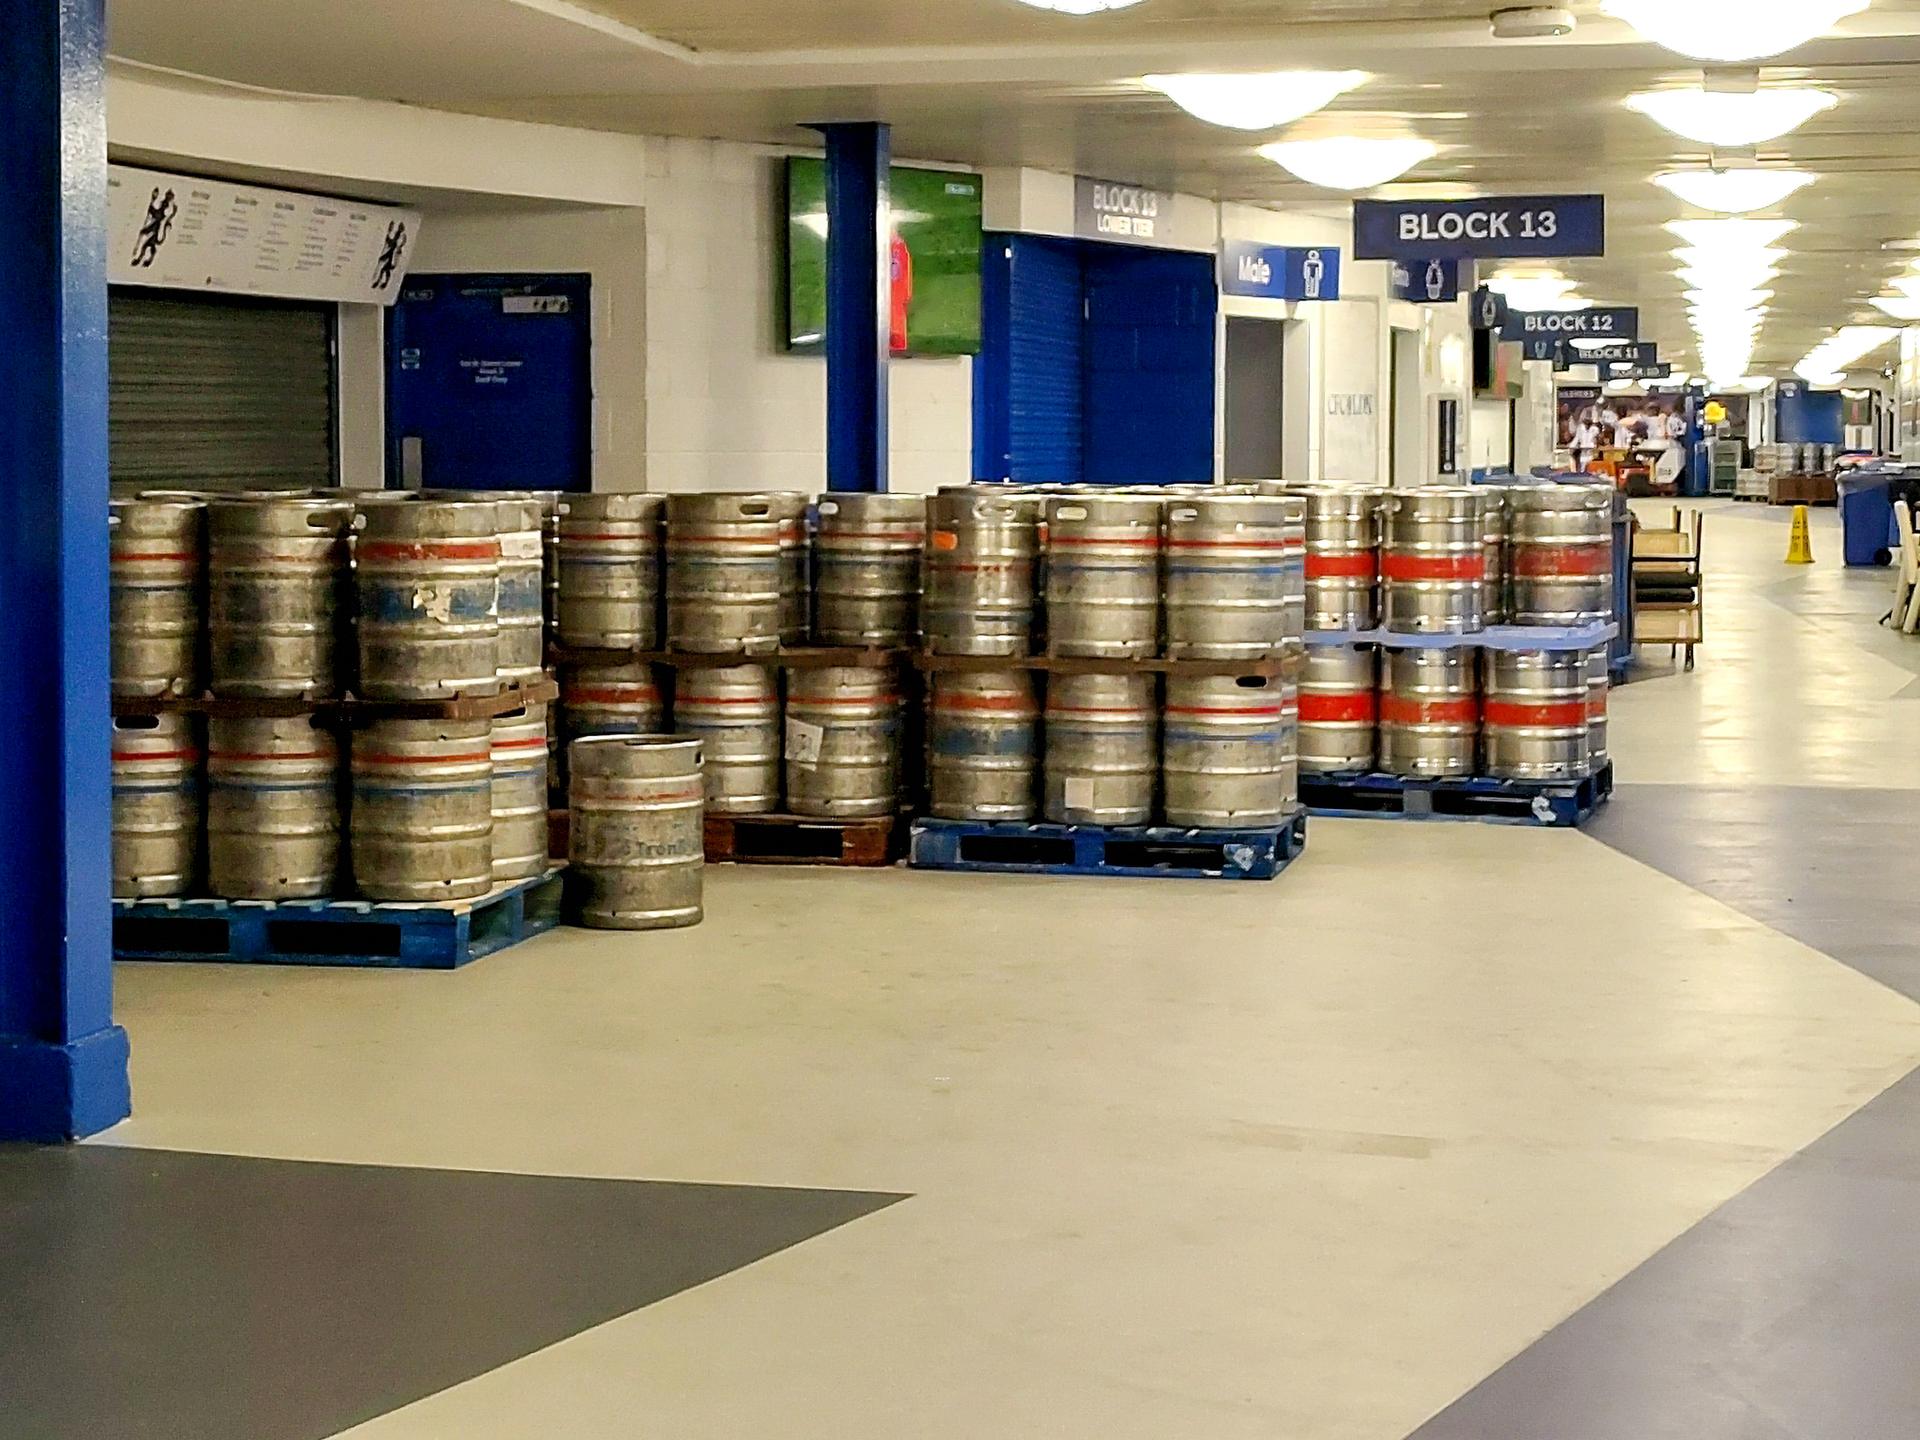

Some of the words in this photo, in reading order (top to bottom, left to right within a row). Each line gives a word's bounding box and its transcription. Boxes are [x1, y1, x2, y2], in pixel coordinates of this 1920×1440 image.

[1093, 184, 1139, 214] BLOCK
[1399, 212, 1510, 240] BLOCK
[1519, 210, 1557, 238] 13
[1238, 255, 1270, 285] Male
[1524, 314, 1586, 332] BLOCK
[1591, 314, 1614, 331] 12
